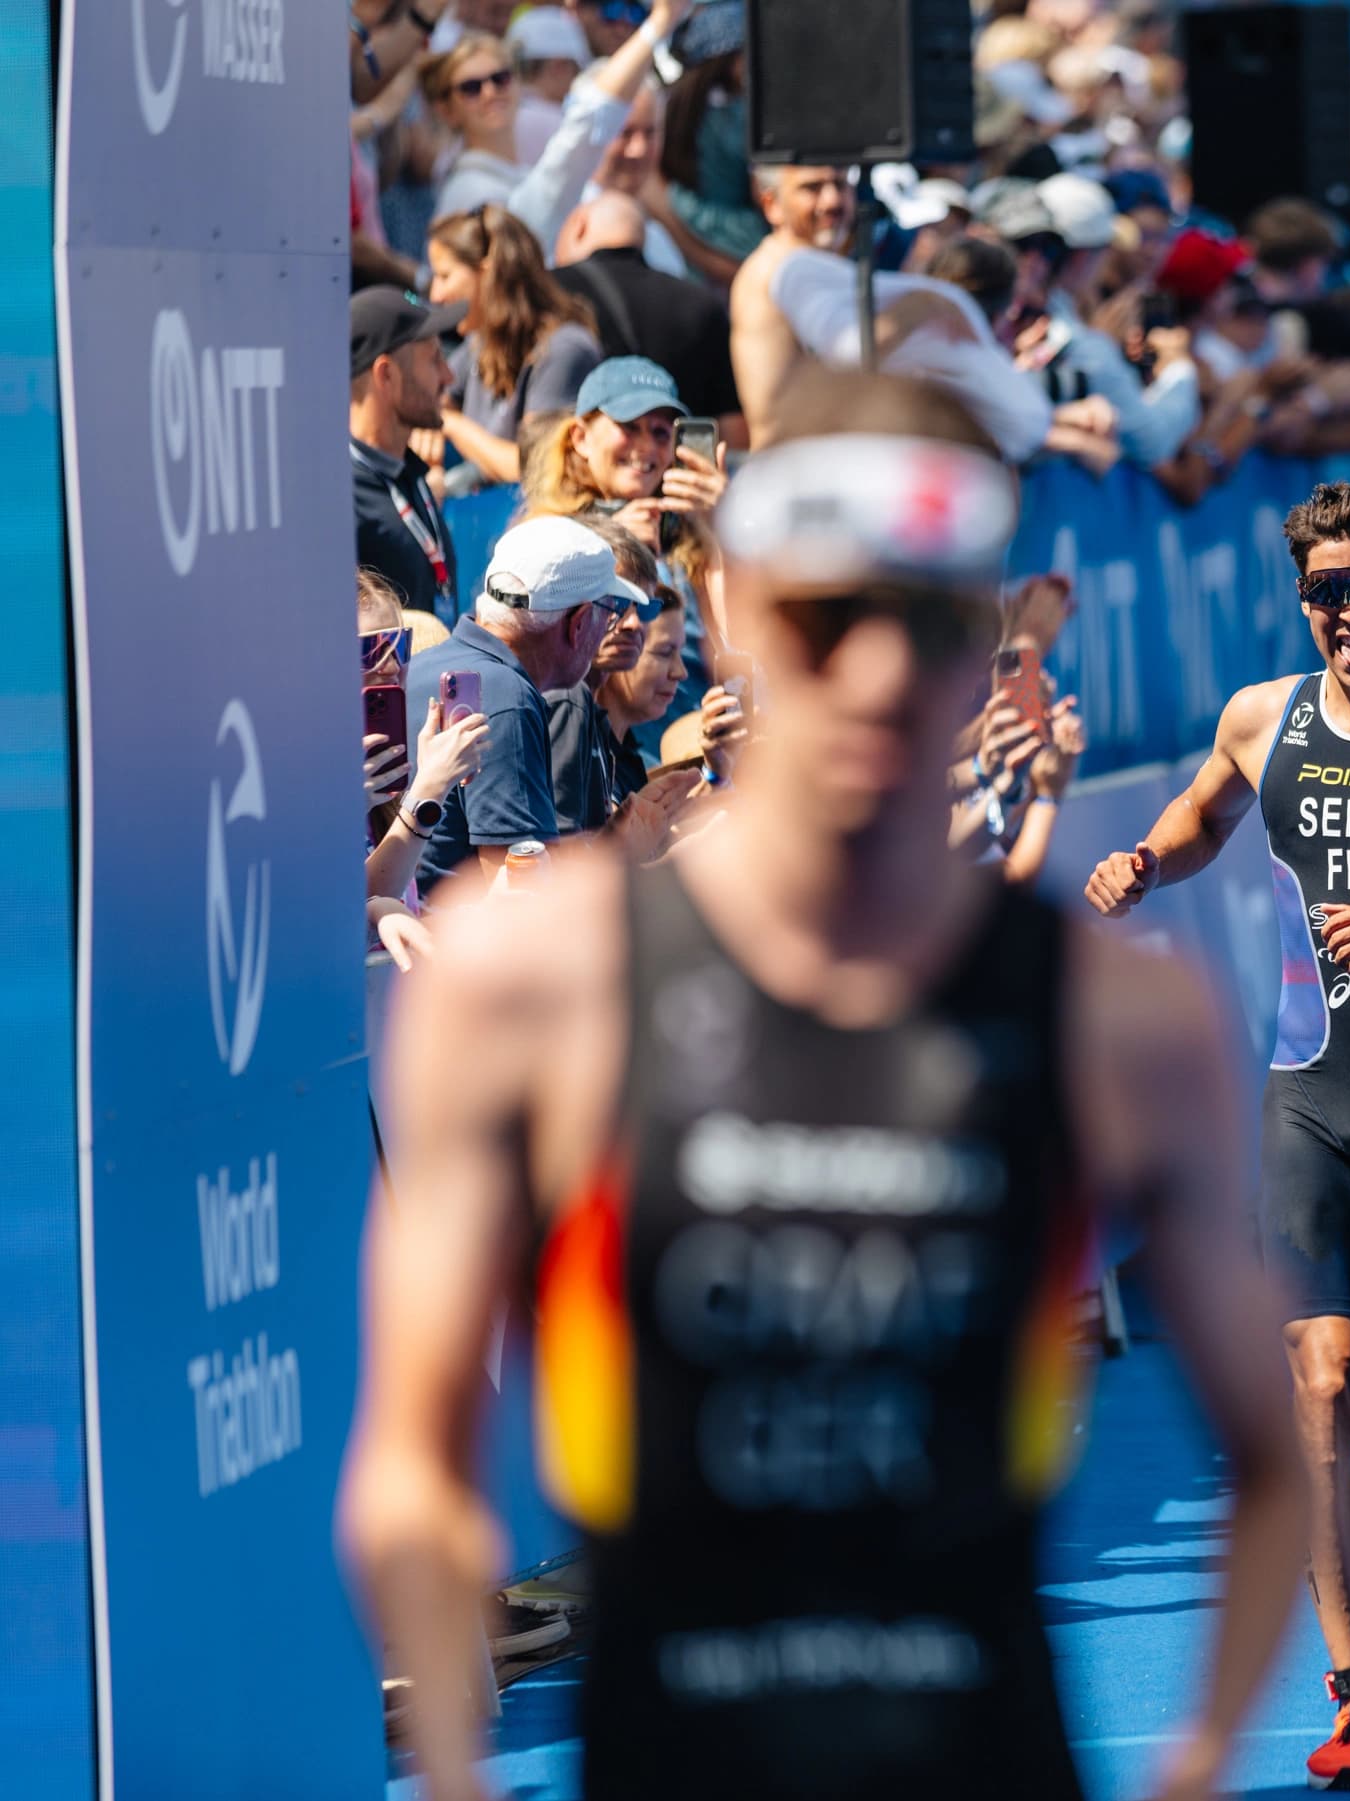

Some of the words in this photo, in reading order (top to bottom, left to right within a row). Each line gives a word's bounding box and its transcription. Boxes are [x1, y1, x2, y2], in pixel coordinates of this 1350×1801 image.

[200, 0, 286, 85] WASSER
[201, 347, 284, 534] NTT
[196, 1150, 280, 1312] World
[187, 1330, 302, 1499] Triathlon
